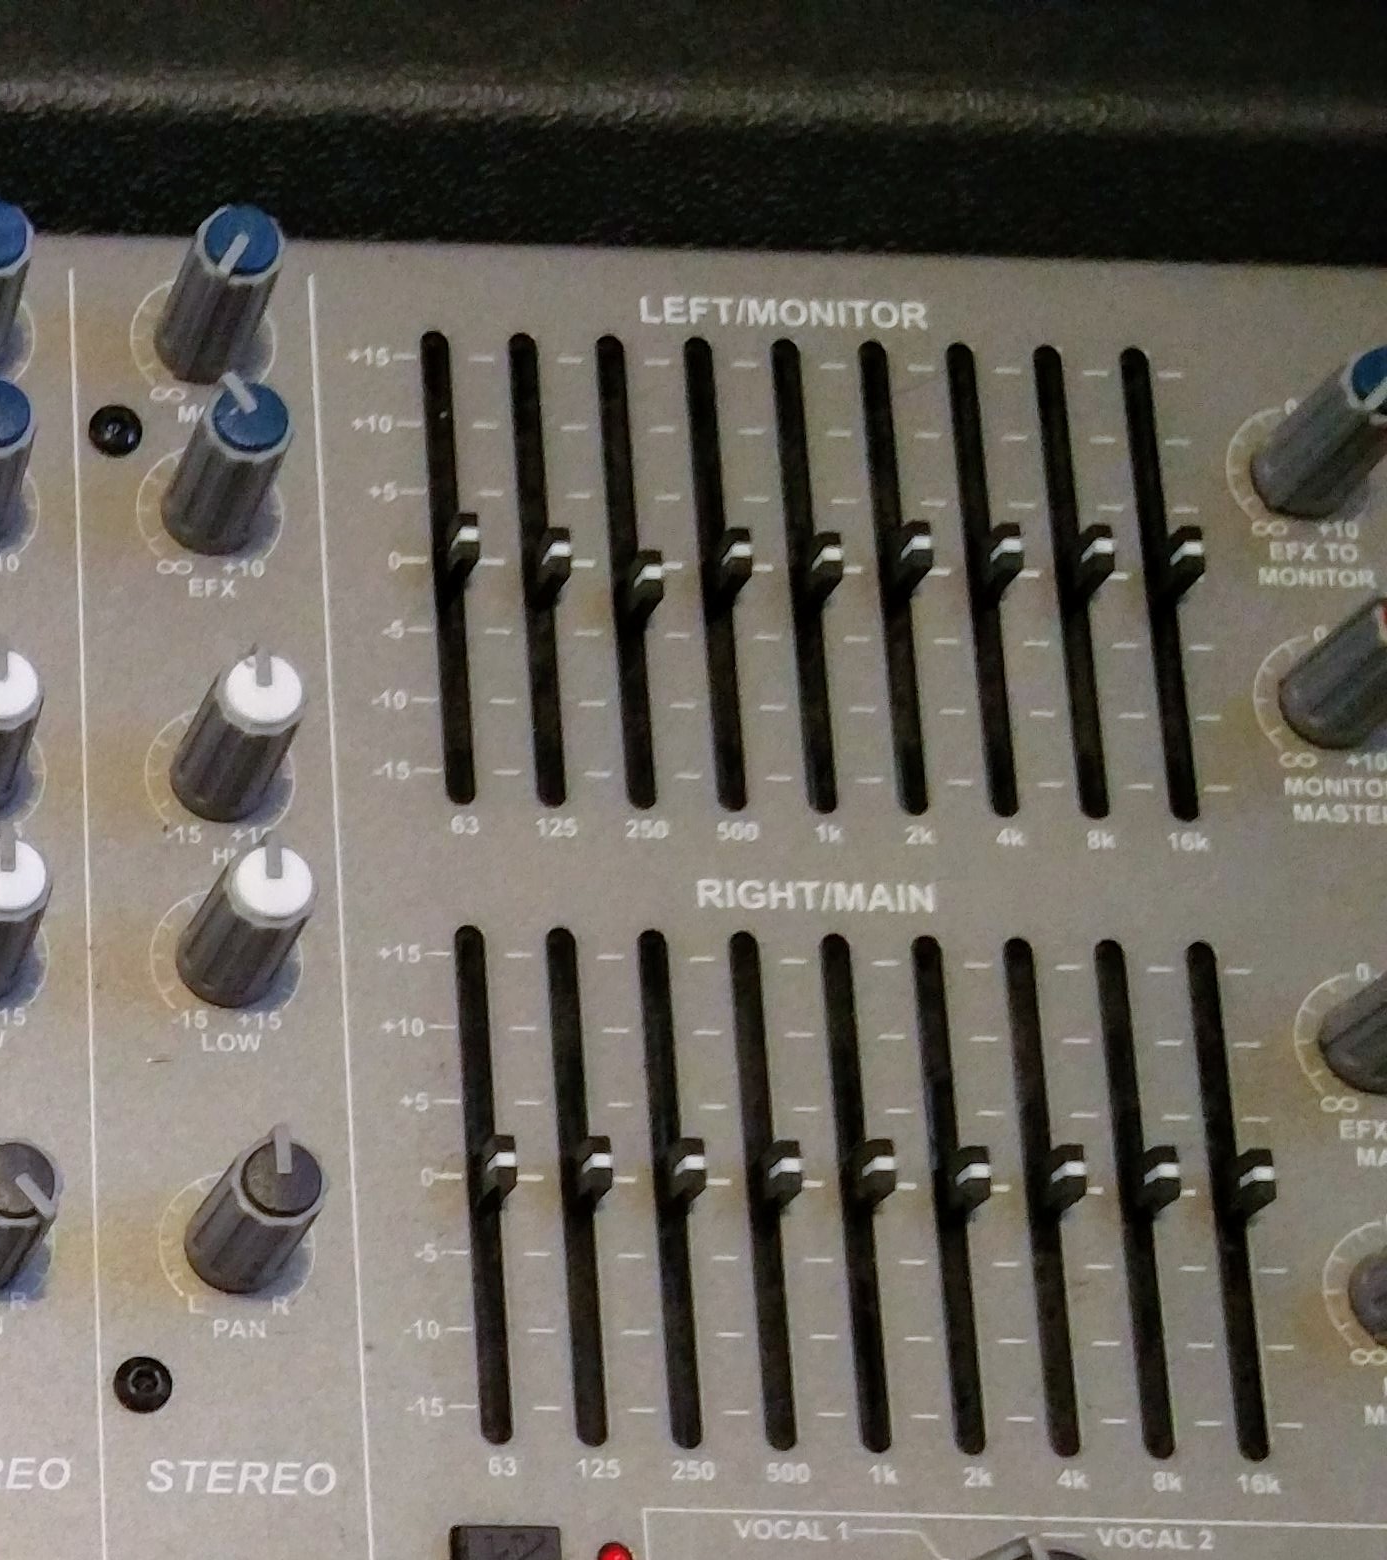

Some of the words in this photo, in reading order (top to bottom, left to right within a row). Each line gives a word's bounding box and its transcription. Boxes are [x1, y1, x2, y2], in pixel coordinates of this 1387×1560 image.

[640, 296, 928, 330] LEFT/MONITOR
[1270, 541, 1317, 561] EFX
[1325, 543, 1359, 562] TO
[1258, 566, 1376, 588] MONITOR
[188, 579, 236, 598] EFX
[1284, 777, 1387, 797] MONITO
[1293, 804, 1387, 824] MASTE
[451, 817, 480, 834] 63
[536, 819, 577, 837] 125
[626, 820, 669, 839] 250
[717, 822, 760, 841] 500
[815, 825, 842, 843] 1k
[905, 826, 936, 845] 2k
[996, 829, 1025, 847] 4k
[1167, 833, 1209, 851] 16k
[696, 878, 935, 914] RIGHT/MAIN
[377, 946, 420, 963] +15
[381, 1019, 424, 1037] +10
[201, 1034, 261, 1052] LOW
[213, 1319, 266, 1339] PAN
[488, 1458, 517, 1476] 63
[575, 1460, 620, 1478] 125
[671, 1461, 715, 1480] 250
[766, 1463, 811, 1482] 500
[869, 1466, 897, 1484] 1k
[147, 1460, 336, 1496] STEREO
[963, 1468, 993, 1487] 2k
[1057, 1470, 1088, 1488] 4k
[1237, 1474, 1281, 1494] 16k
[735, 1520, 829, 1539] VOCAL
[836, 1521, 850, 1540] 1
[1096, 1527, 1194, 1549] VOCAL
[1198, 1530, 1214, 1550] 2
